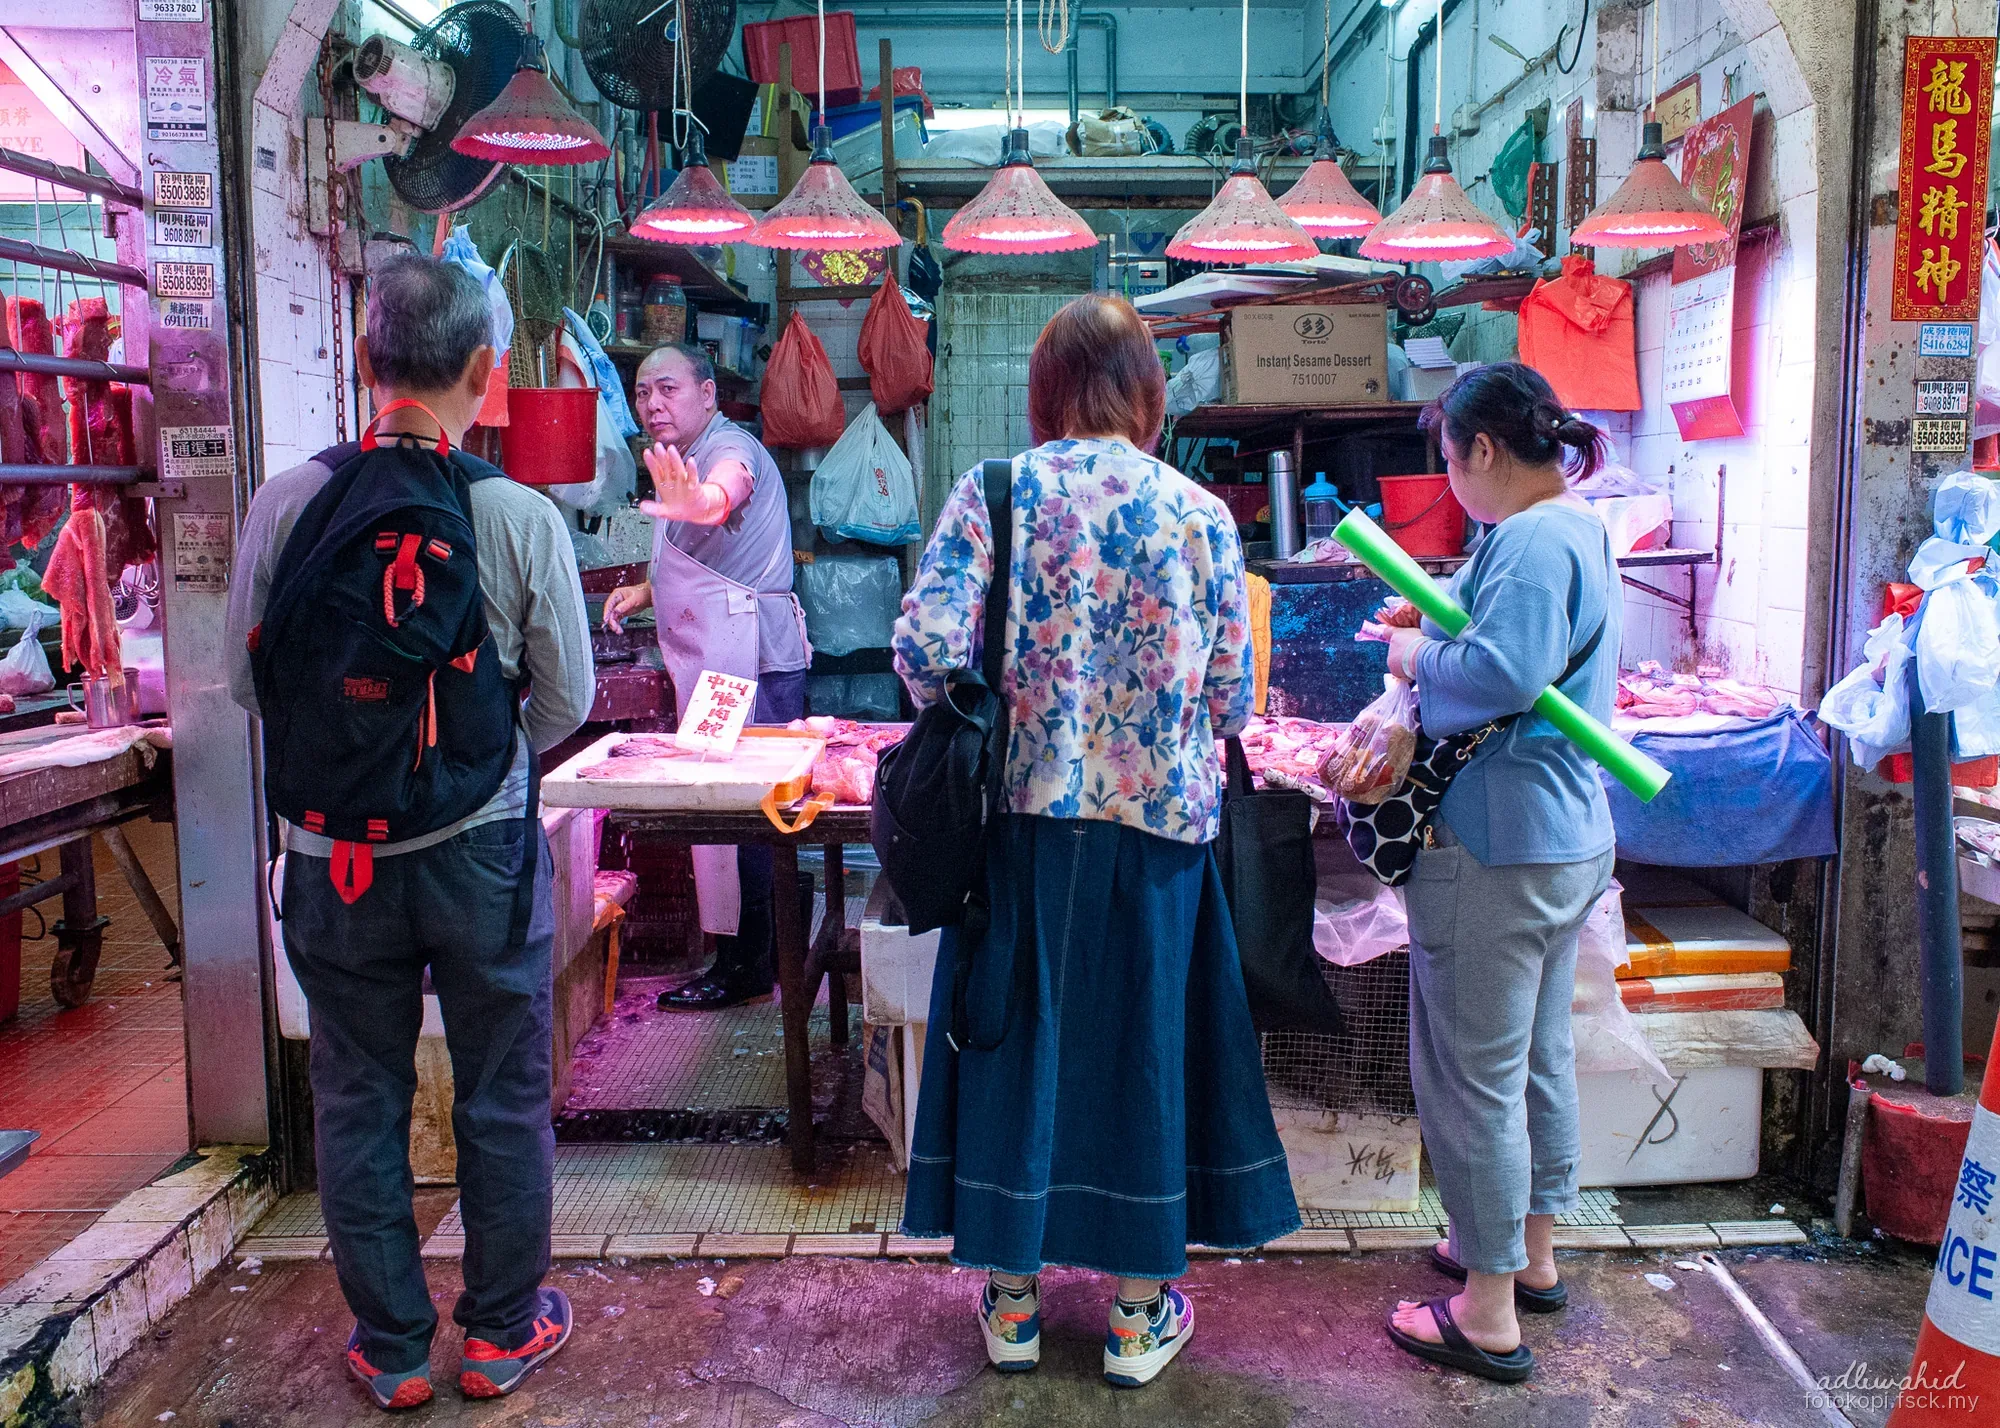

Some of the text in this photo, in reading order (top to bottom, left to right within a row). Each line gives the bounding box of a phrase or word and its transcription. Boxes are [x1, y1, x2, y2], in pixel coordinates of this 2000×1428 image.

[154, 4, 175, 12] 9633
[176, 4, 197, 12] 7802
[154, 66, 198, 86] 冷氣
[1914, 57, 1972, 304] 龍馬精神
[159, 213, 208, 228] 明興捲閘
[164, 314, 209, 328] 69111711
[1302, 317, 1325, 335] 多多
[1923, 339, 1968, 350] 5416 6284
[1256, 353, 1371, 368] Instant Sesame Dessert
[1291, 373, 1337, 386] 7510007
[1920, 382, 1966, 394] 明興捲閘
[174, 441, 224, 457] 通渠王
[182, 521, 224, 540] 冷氣
[707, 674, 749, 696] 中山
[1957, 1157, 1997, 1216] 察
[1938, 1228, 1997, 1301] ICE
